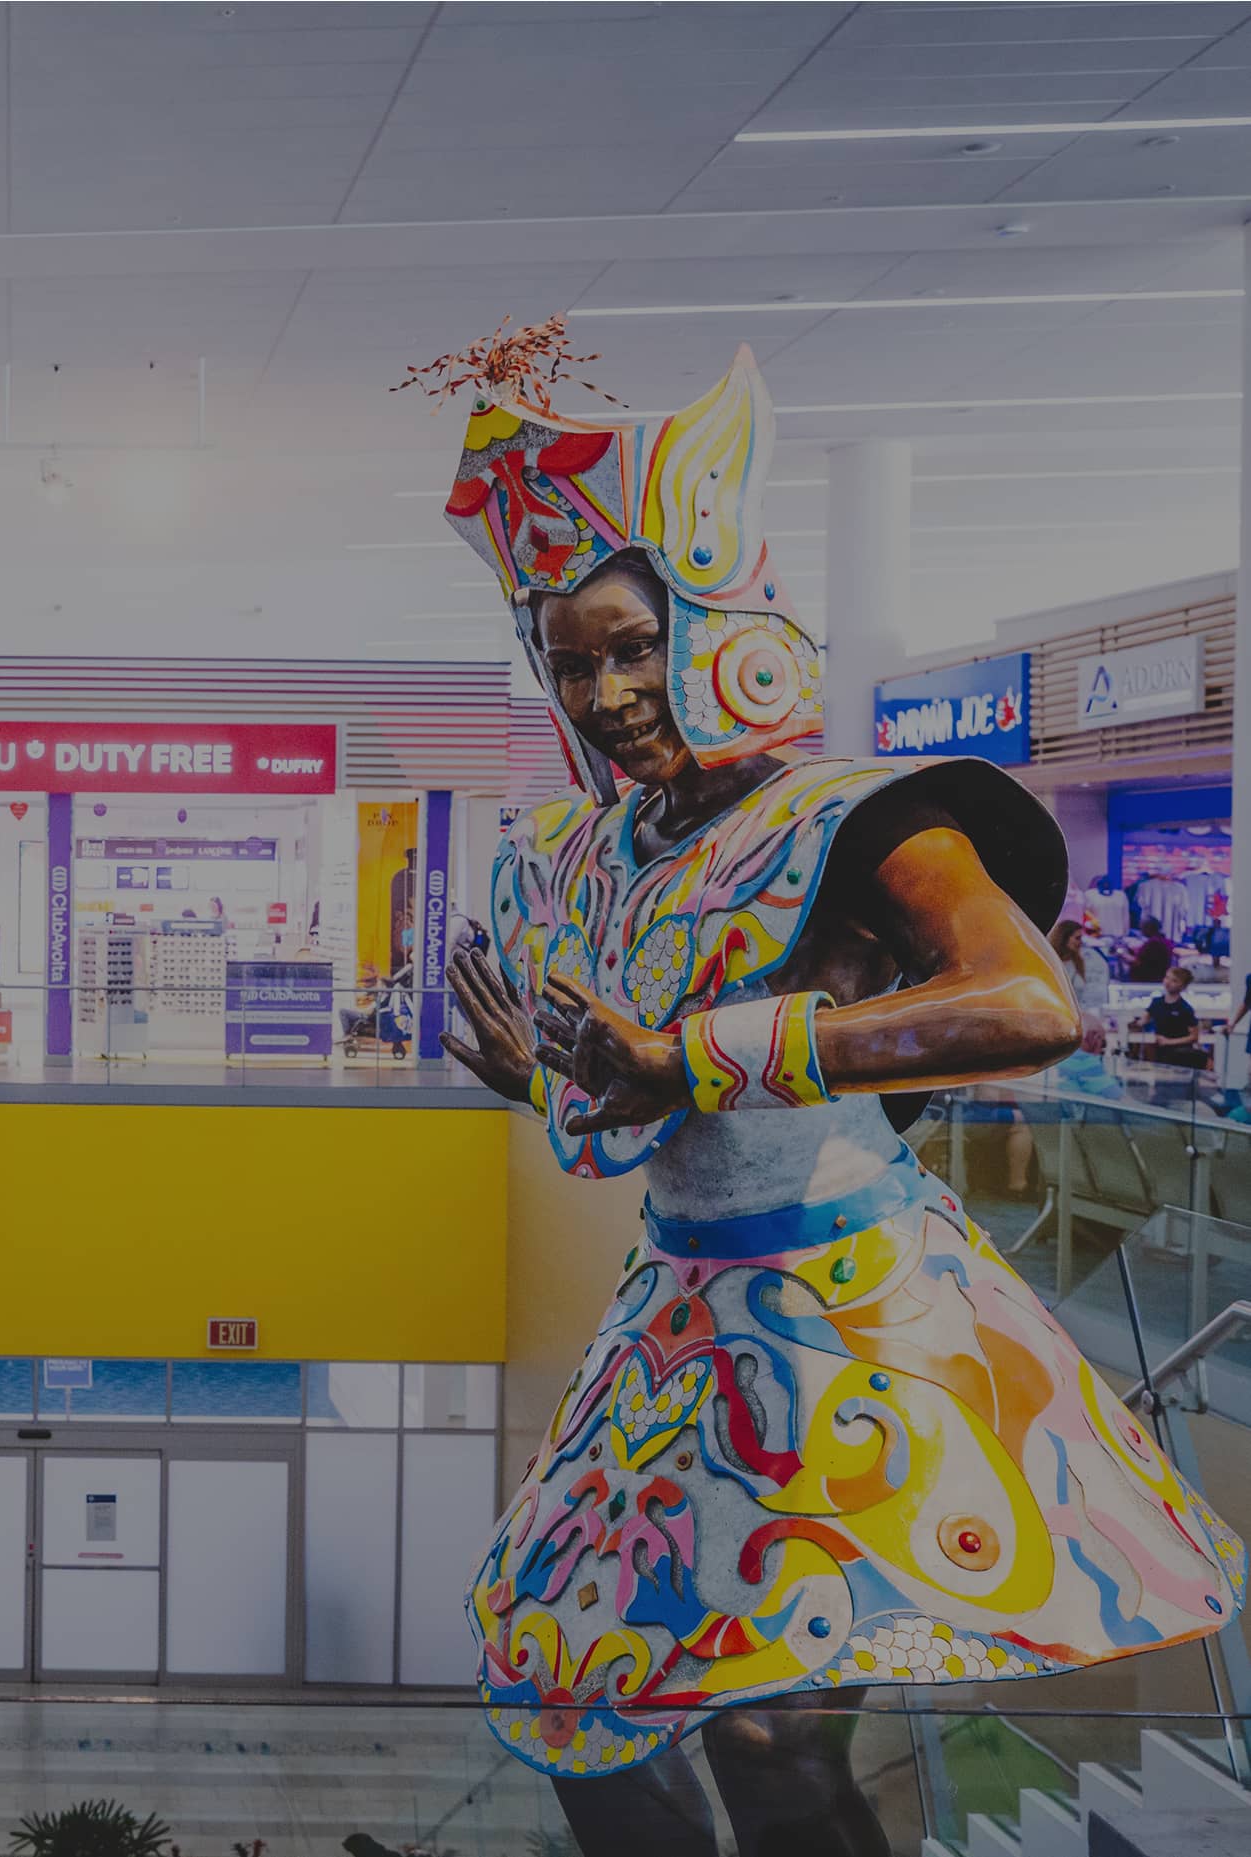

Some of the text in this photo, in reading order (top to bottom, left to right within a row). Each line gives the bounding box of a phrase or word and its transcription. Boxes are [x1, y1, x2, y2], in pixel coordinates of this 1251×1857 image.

[1123, 657, 1195, 697] ADORN
[956, 693, 994, 739] JOE
[55, 743, 146, 772] DUTY
[150, 744, 233, 773] FREE
[271, 758, 324, 774] DUFRY
[373, 812, 393, 820] PN
[52, 893, 68, 982] ClubAvolta
[426, 898, 444, 986] ClubAvolta
[219, 1322, 248, 1345] EXIT
